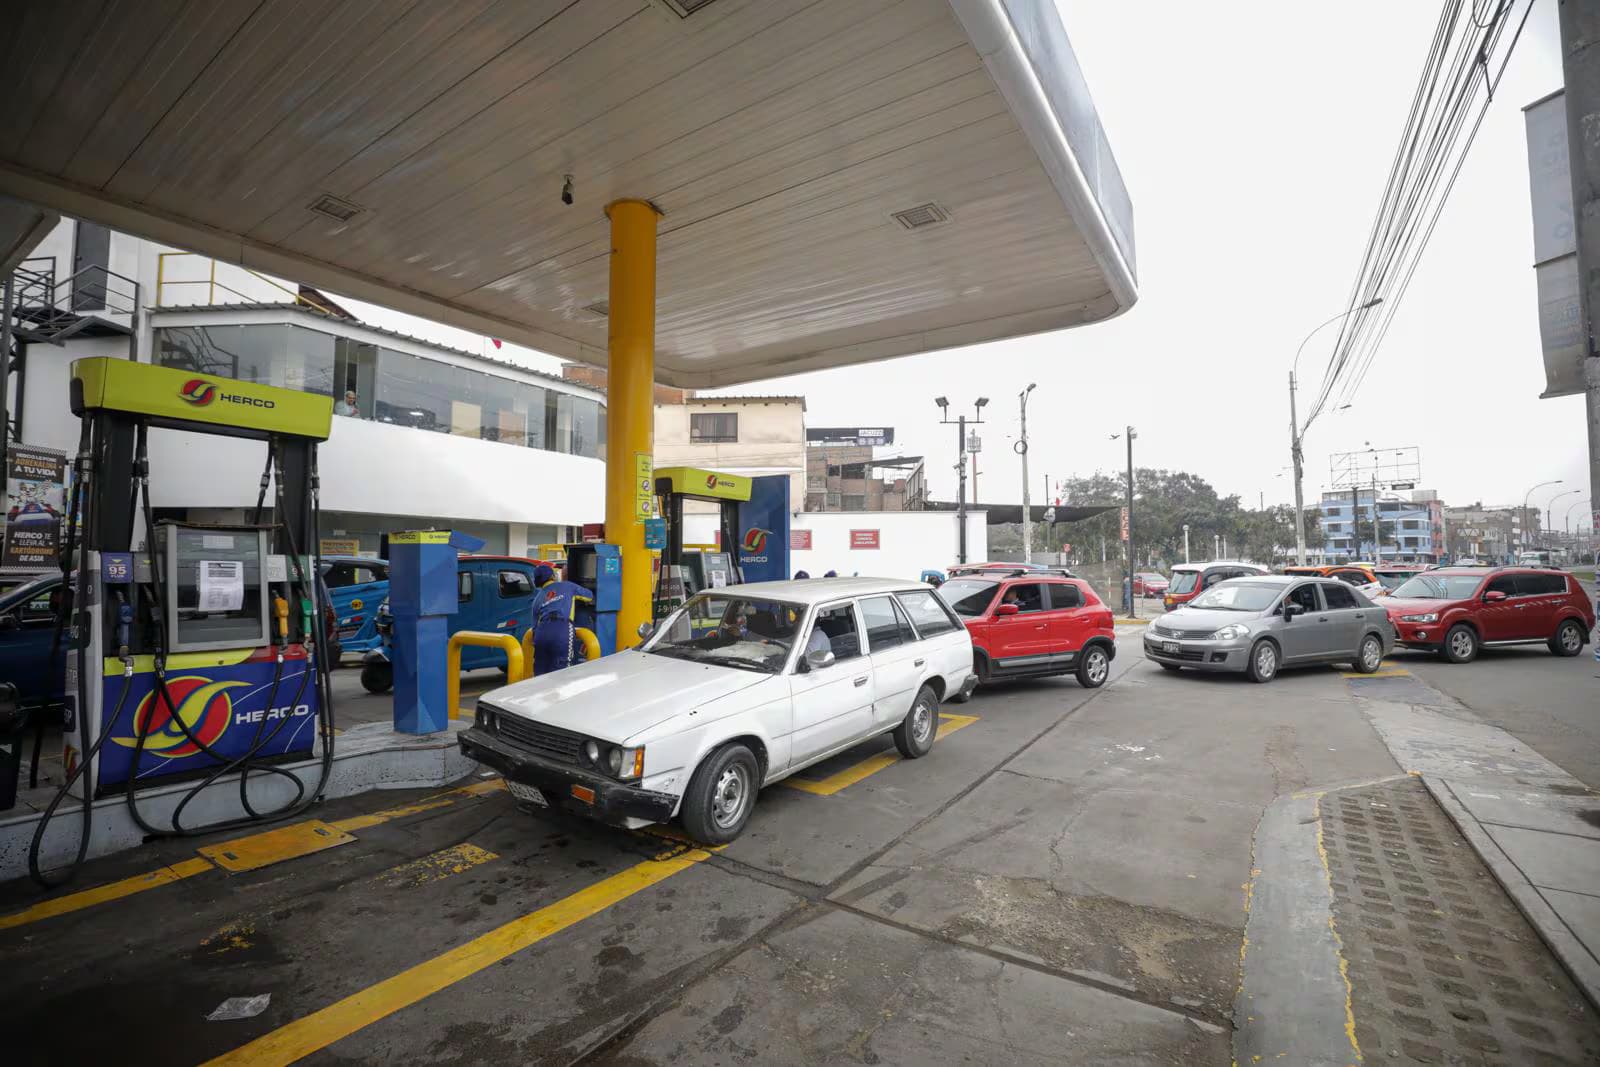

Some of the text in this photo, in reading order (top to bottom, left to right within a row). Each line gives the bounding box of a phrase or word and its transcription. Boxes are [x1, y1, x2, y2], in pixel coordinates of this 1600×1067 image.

[220, 393, 275, 409] HERCO
[24, 466, 35, 474] TU
[36, 468, 57, 476] VIDA
[14, 531, 43, 540] HERCO
[108, 566, 127, 575] 95
[236, 704, 309, 725] HERCO
